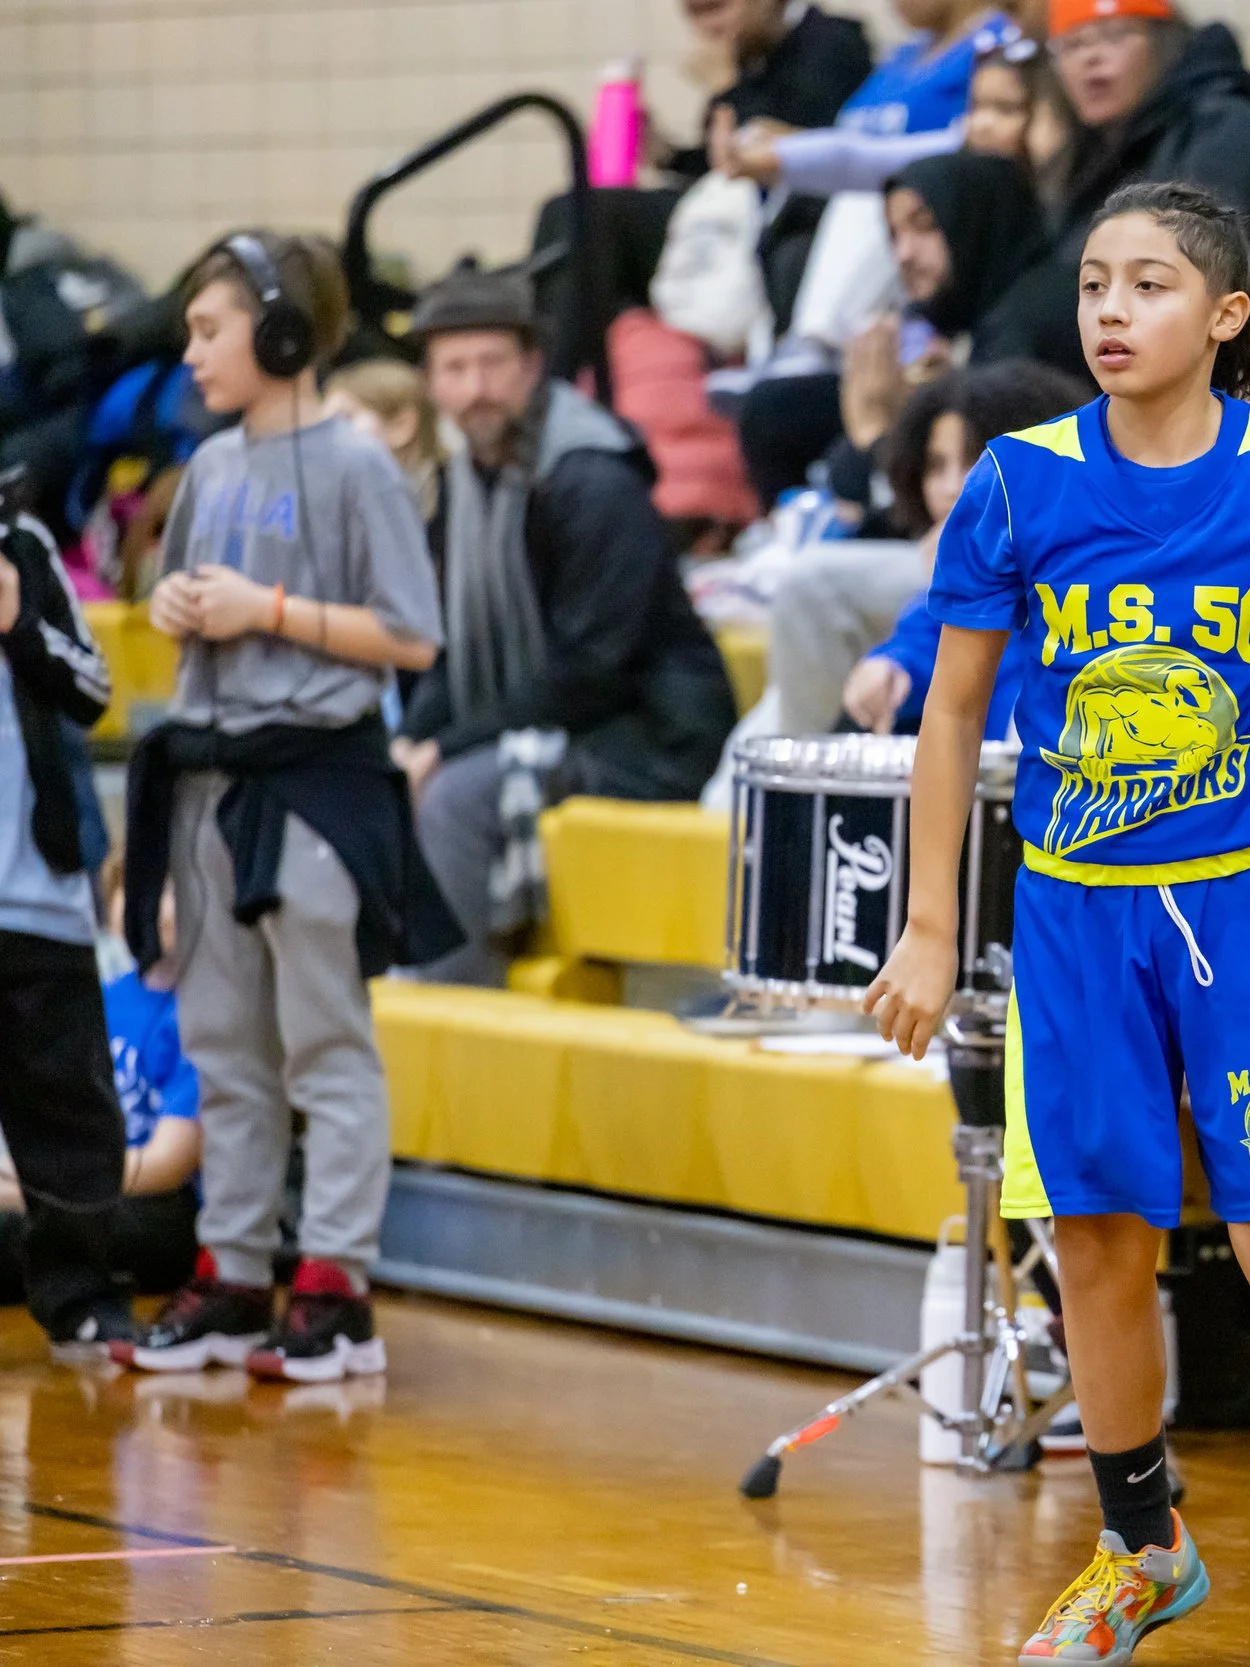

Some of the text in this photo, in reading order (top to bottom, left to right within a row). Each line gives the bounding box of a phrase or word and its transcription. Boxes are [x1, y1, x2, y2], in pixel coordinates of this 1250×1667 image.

[1035, 583, 1171, 667] M.S.
[1043, 742, 1250, 857] WARRORS
[828, 813, 894, 970] Pearl
